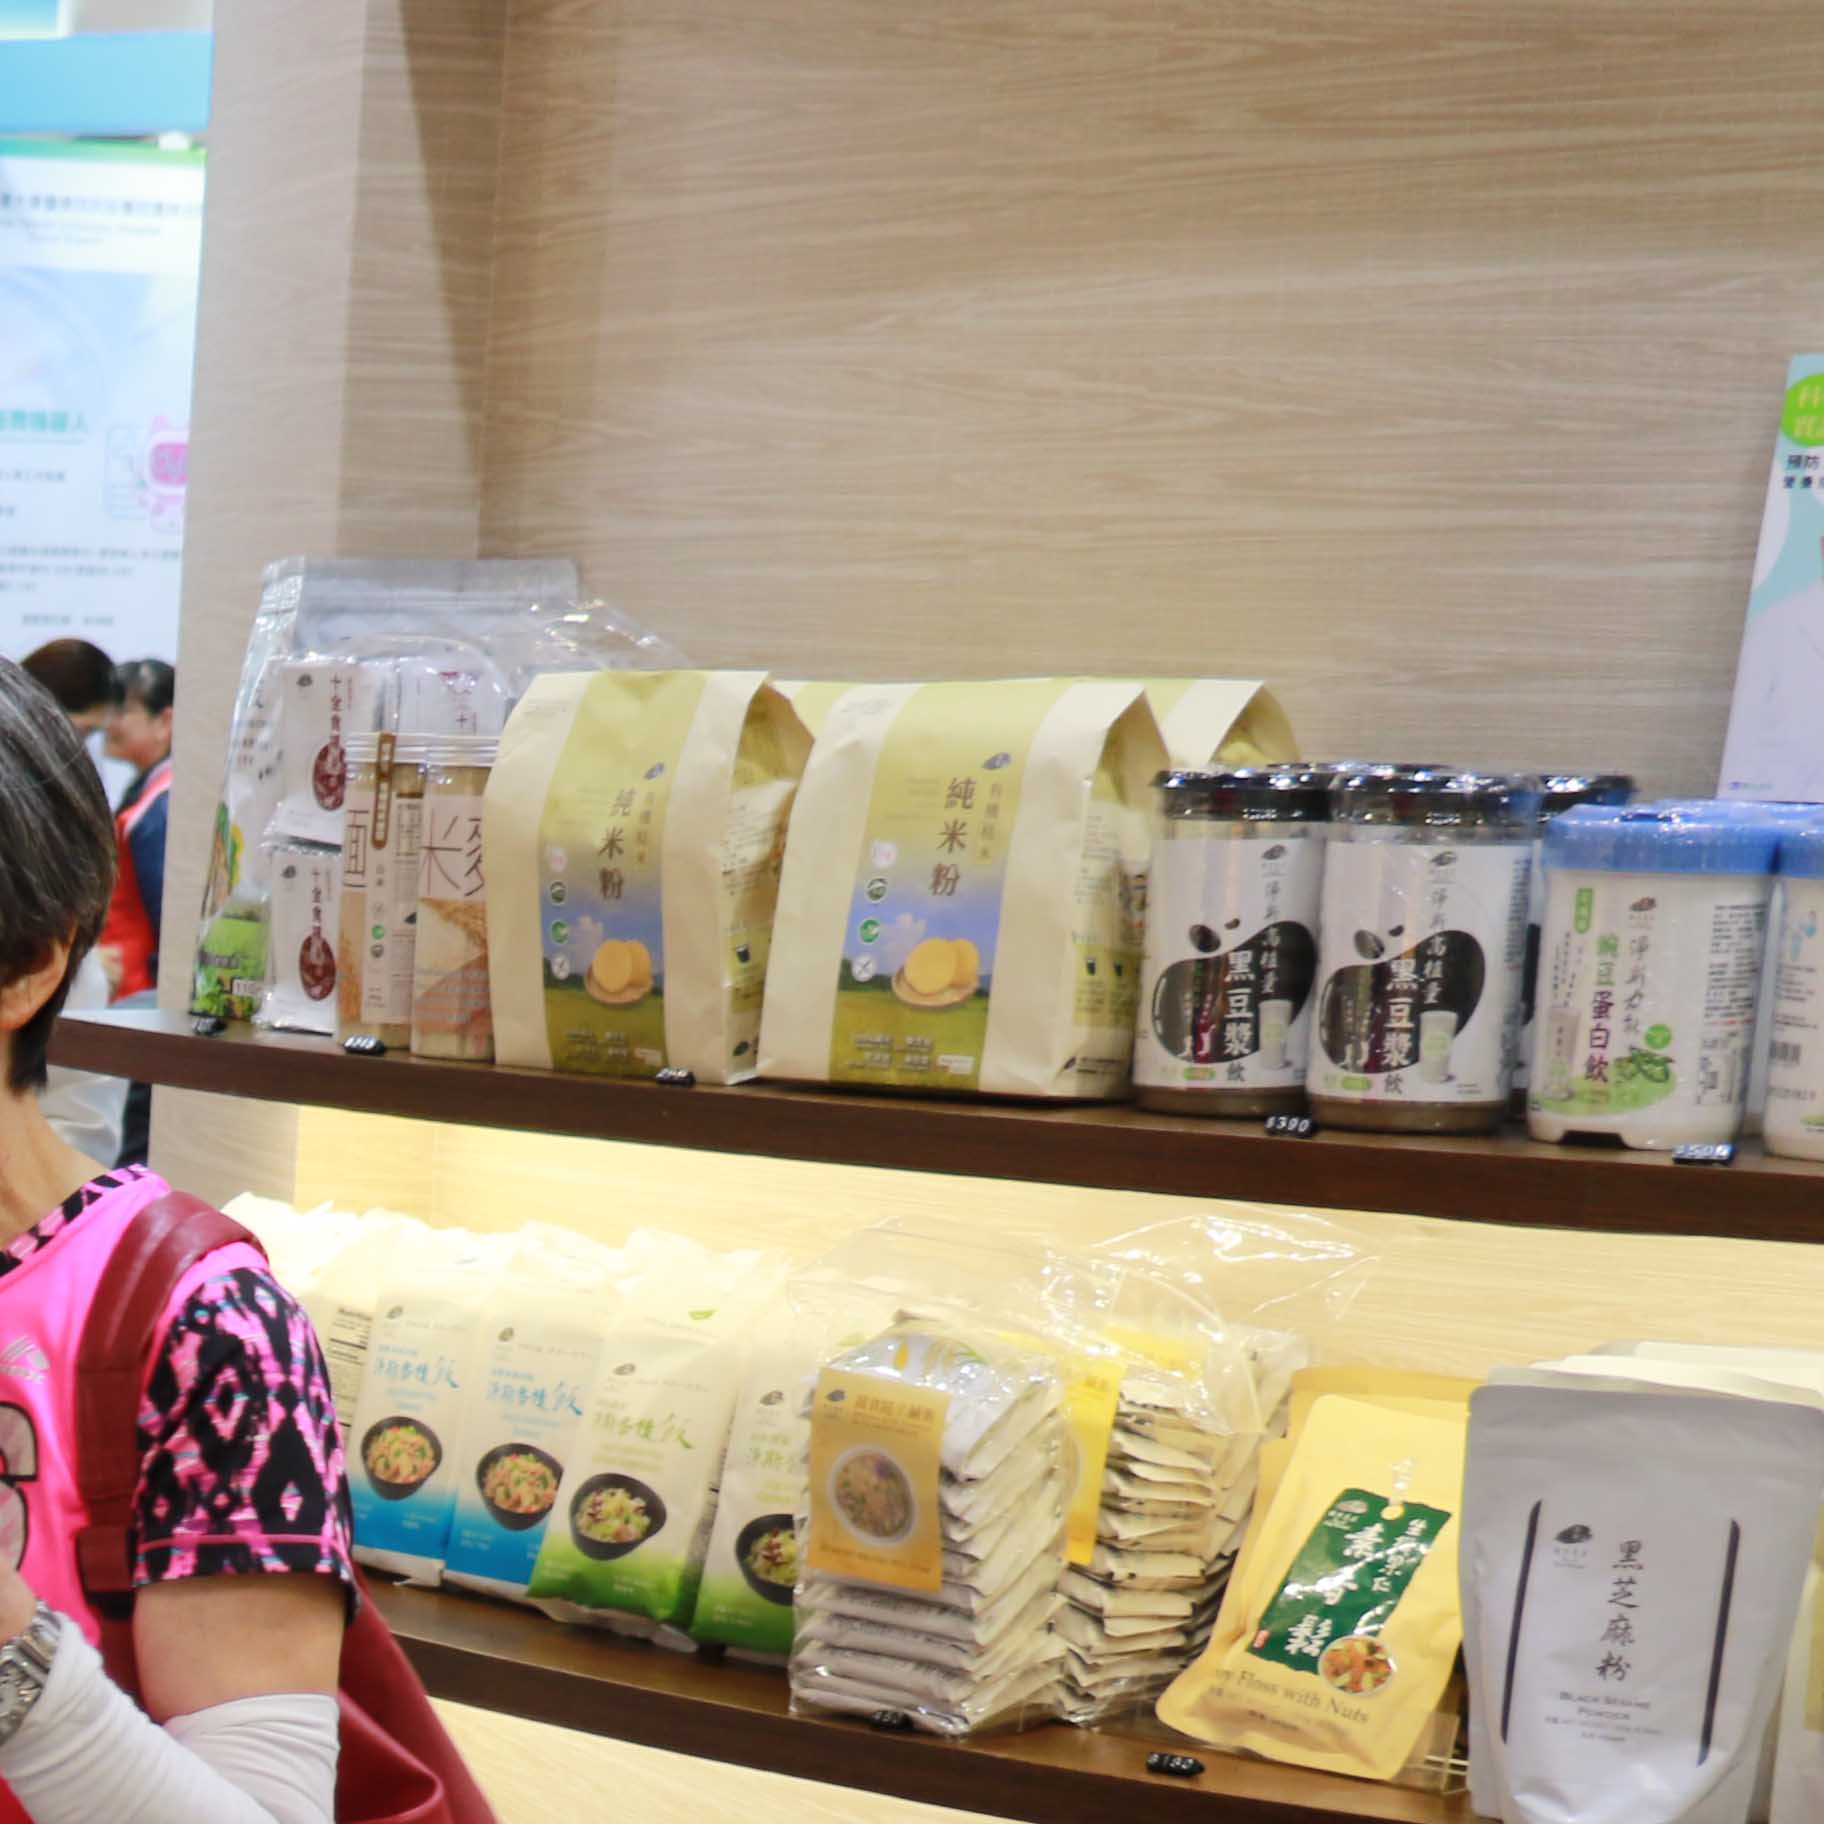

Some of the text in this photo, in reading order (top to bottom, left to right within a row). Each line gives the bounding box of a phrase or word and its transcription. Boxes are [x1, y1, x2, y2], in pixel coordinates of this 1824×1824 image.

[599, 789, 636, 900] 純米粉
[928, 777, 977, 897] 純米粉
[1595, 1540, 1645, 1682] 黑芝麻粉
